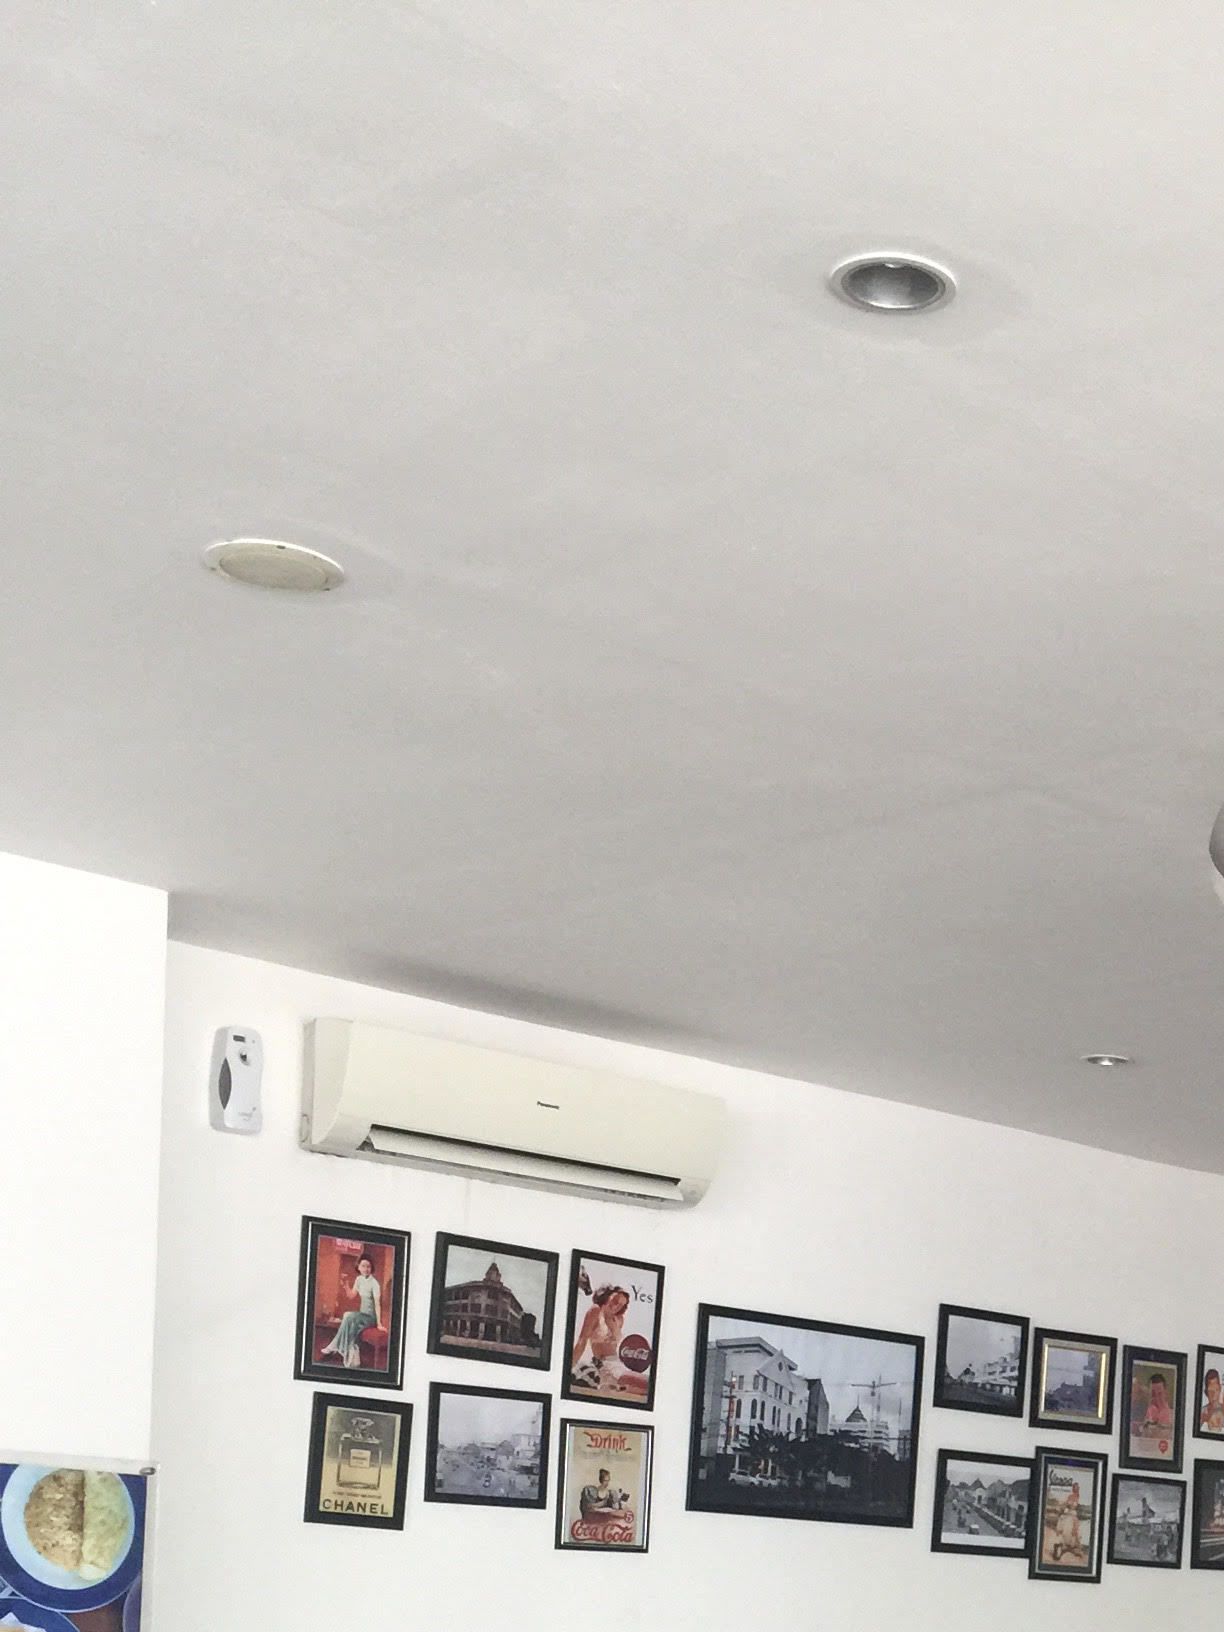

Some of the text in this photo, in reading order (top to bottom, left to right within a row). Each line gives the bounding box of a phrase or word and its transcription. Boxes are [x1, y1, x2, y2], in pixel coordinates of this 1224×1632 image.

[632, 1285, 653, 1303] Yes
[584, 1431, 632, 1453] Drink
[323, 1499, 389, 1515] CHANEL
